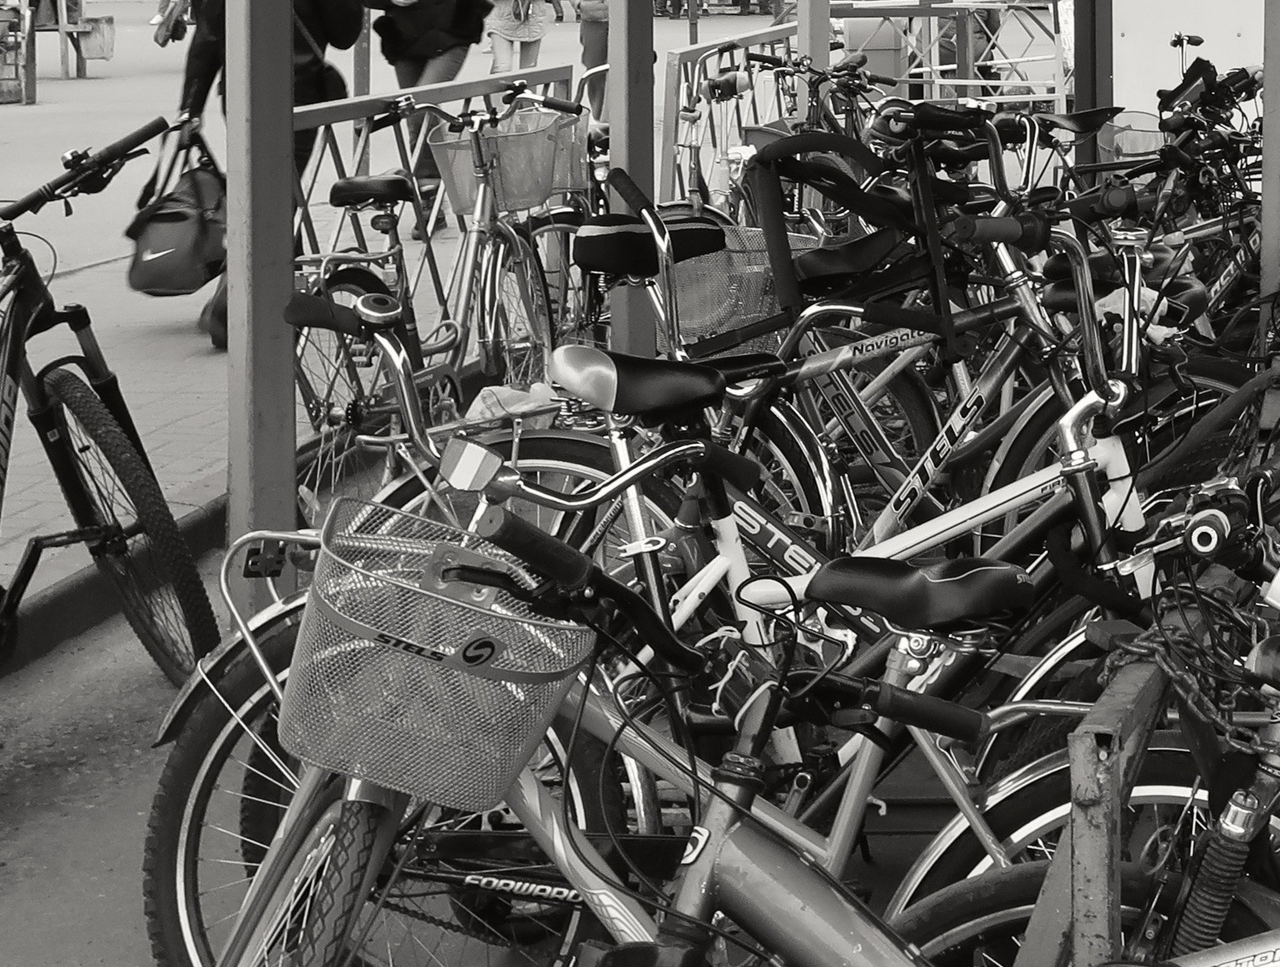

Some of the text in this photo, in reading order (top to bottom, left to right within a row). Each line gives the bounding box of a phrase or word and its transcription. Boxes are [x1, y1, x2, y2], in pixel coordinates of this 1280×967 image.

[852, 331, 927, 356] Navigato
[892, 386, 986, 520] STELS
[374, 634, 447, 662] STELS
[464, 875, 583, 902] FORWARD
